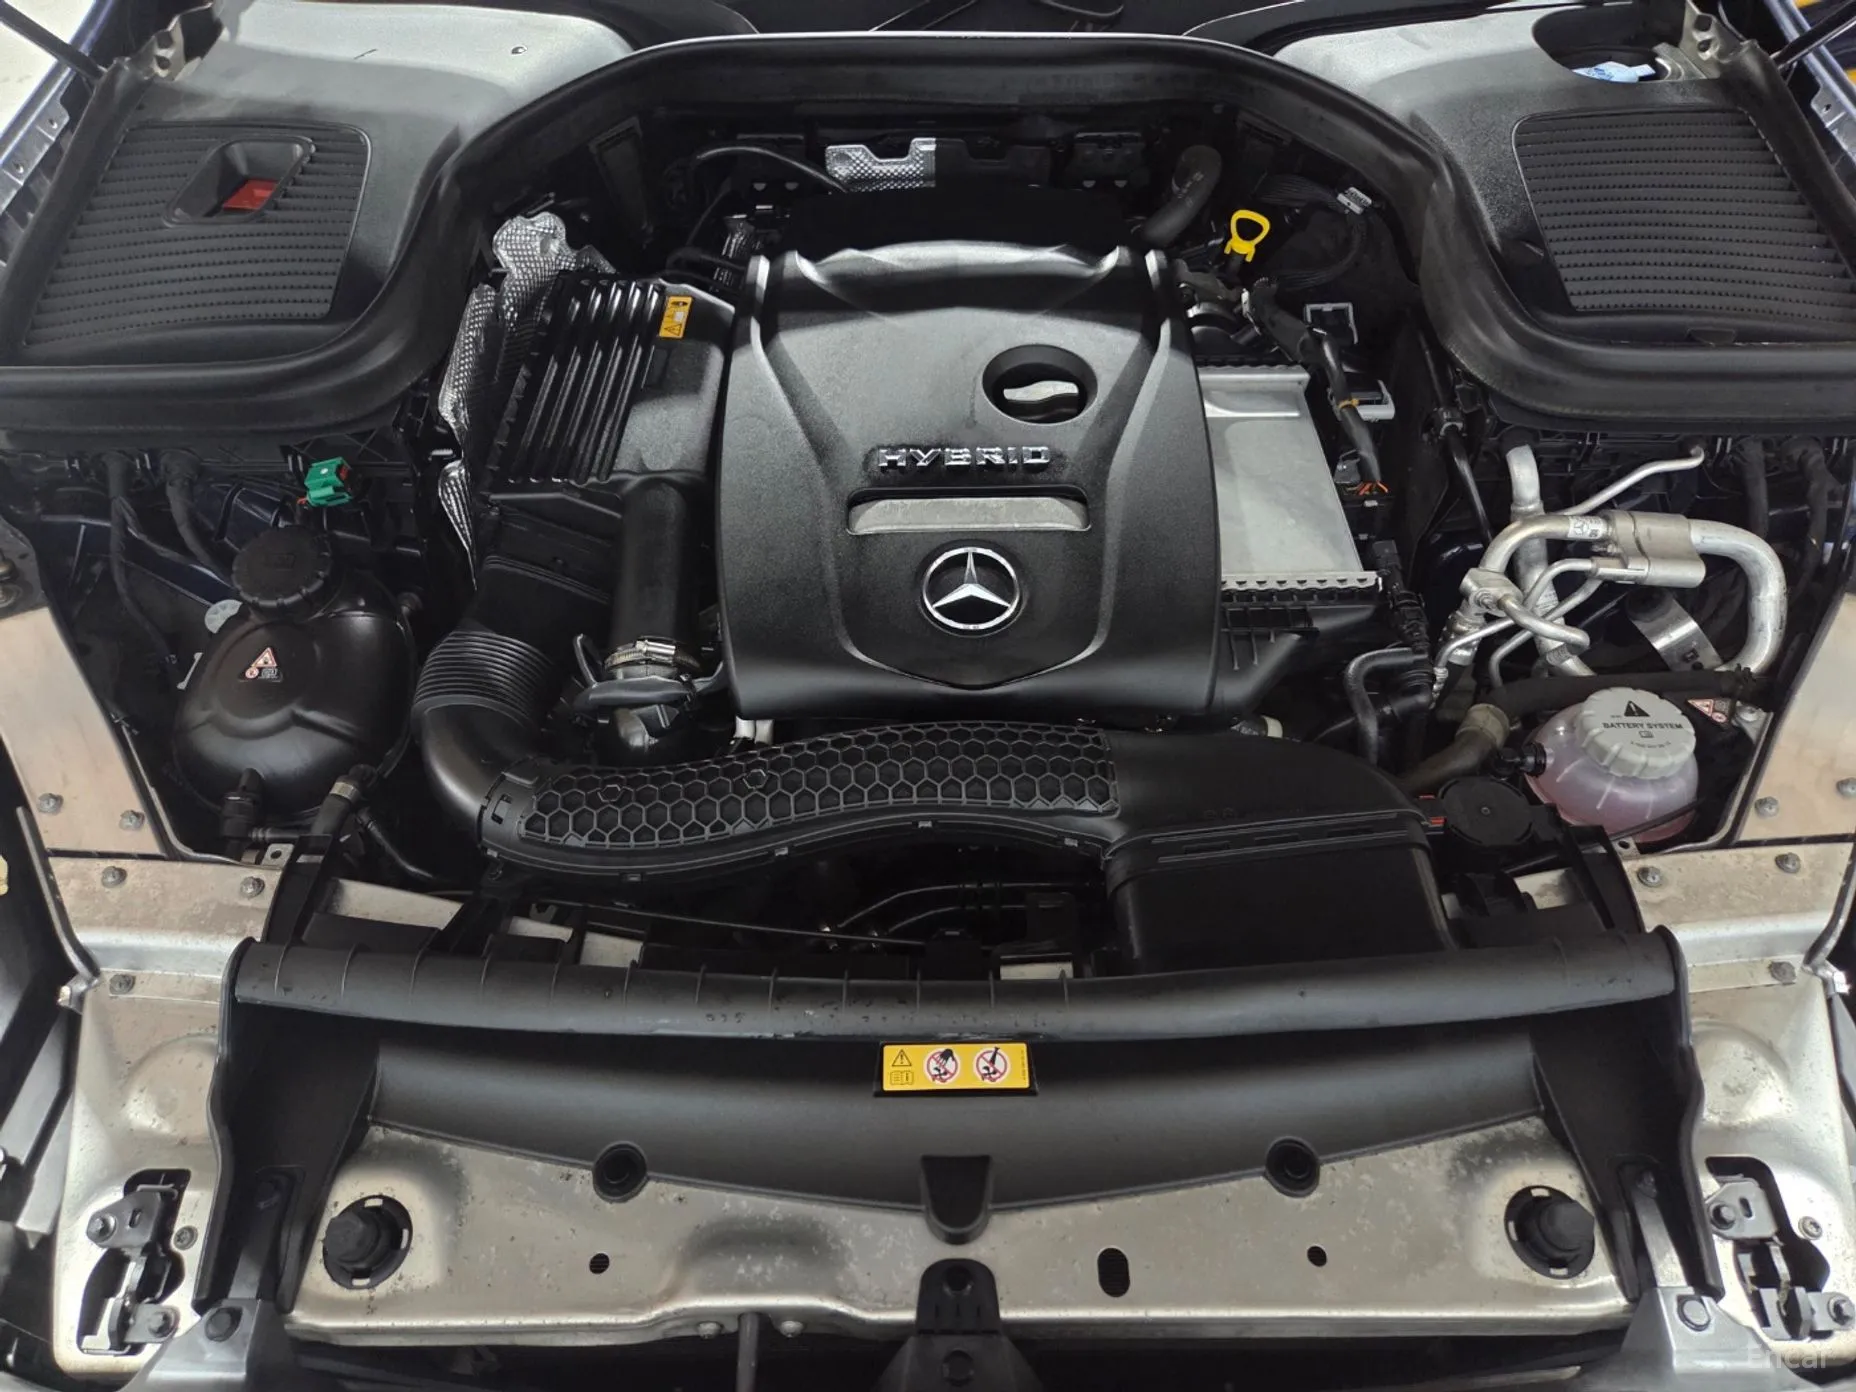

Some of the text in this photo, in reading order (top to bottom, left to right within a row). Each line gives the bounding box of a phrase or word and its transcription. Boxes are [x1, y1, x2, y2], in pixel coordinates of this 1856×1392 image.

[878, 446, 1050, 467] HYBRID
[1602, 722, 1684, 730] BATTERY SYSTEM
